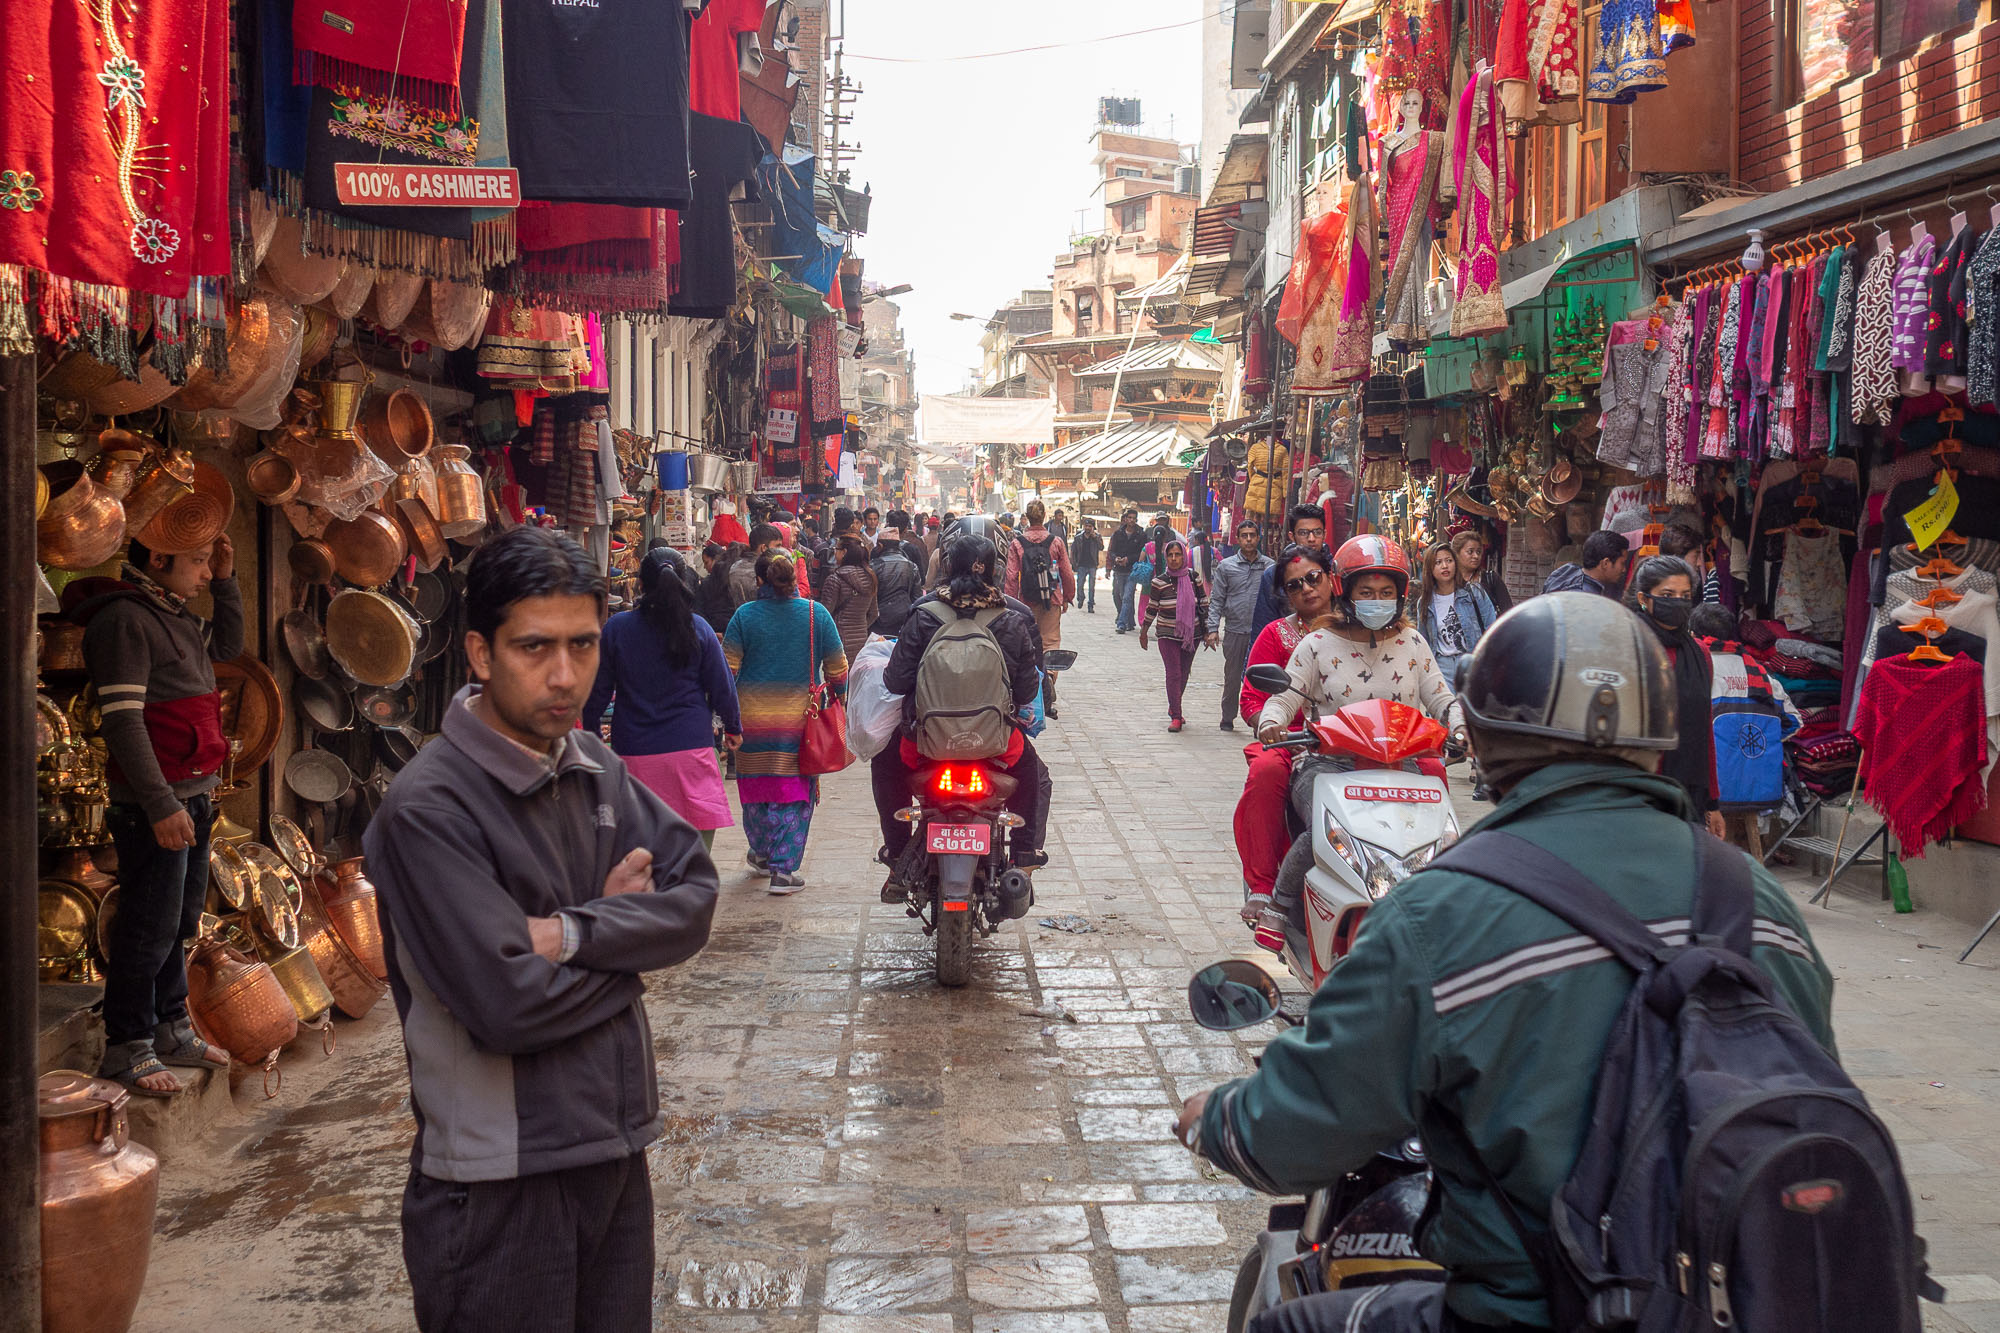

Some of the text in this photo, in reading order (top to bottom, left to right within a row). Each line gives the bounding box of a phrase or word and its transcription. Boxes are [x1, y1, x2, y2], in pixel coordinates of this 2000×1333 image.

[346, 171, 512, 199] 100% CASHMERE
[969, 829, 976, 838] प
[932, 837, 985, 851] ६७८७
[1332, 1233, 1421, 1257] SUZUK
